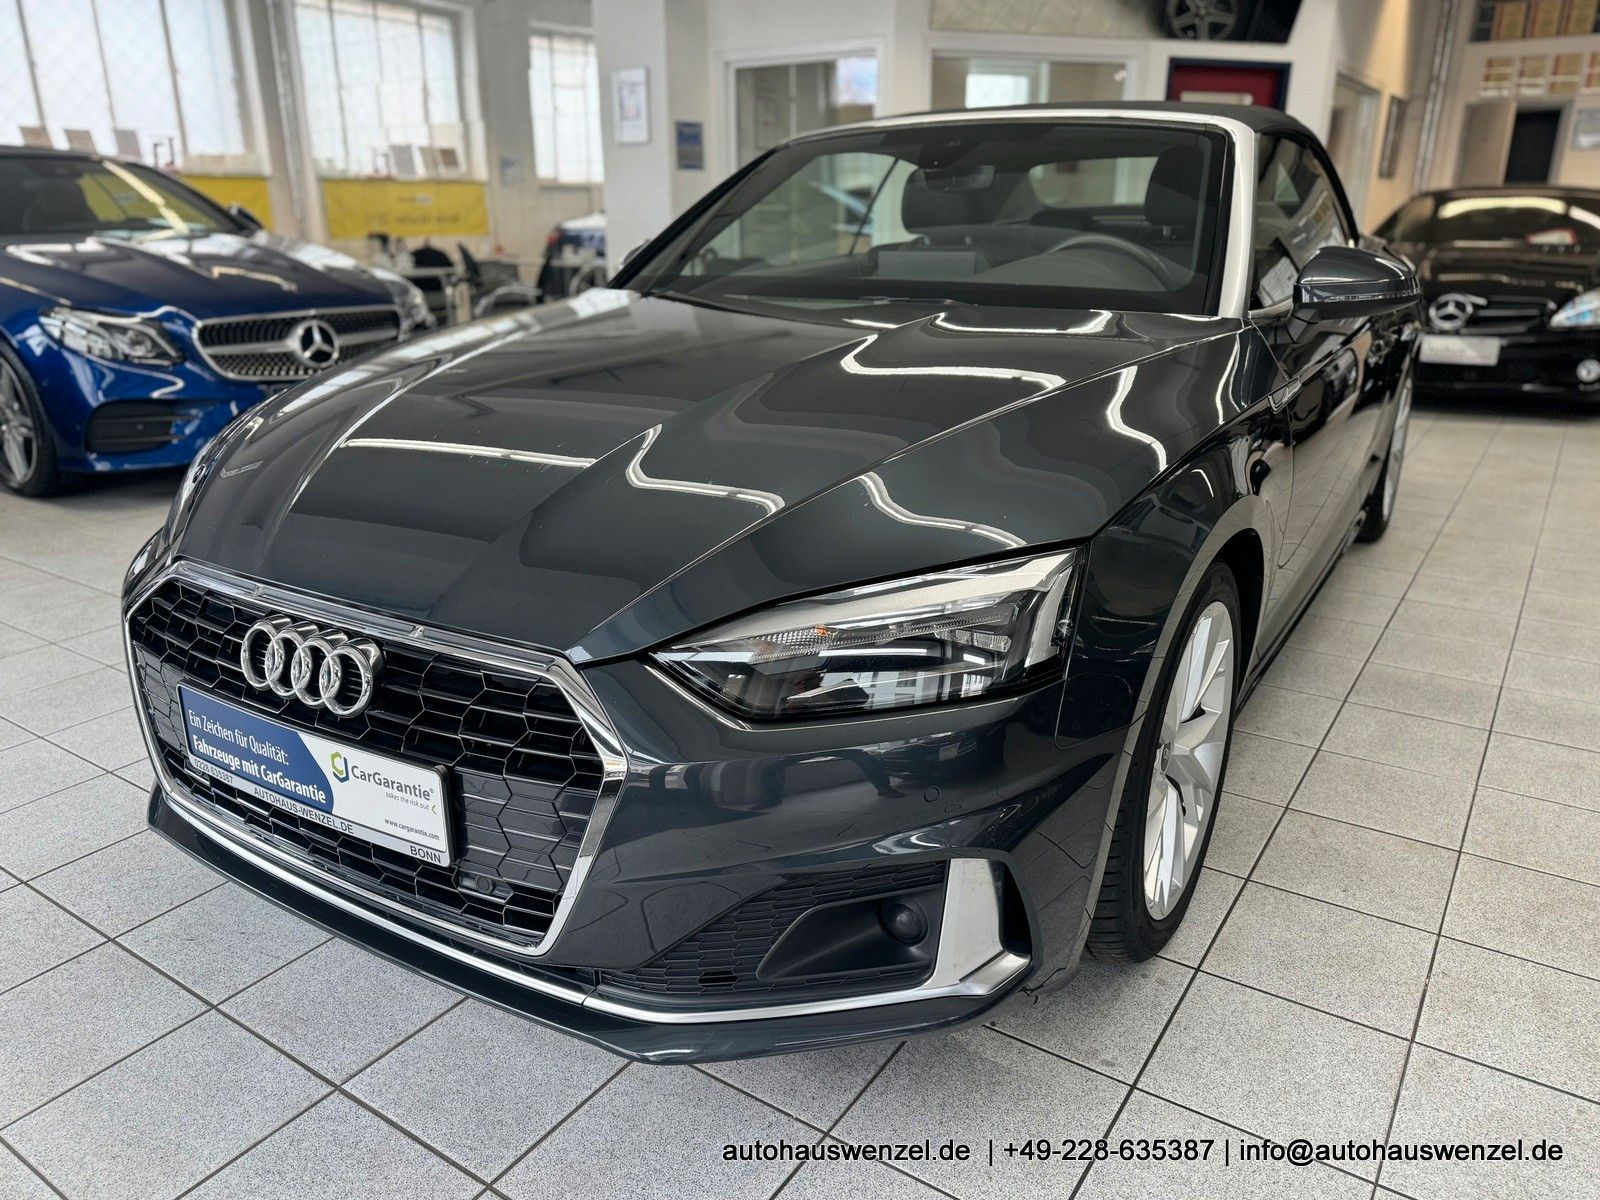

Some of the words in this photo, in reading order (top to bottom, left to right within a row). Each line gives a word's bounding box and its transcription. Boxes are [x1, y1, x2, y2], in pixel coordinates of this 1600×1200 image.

[189, 709, 202, 728] Ein
[201, 715, 235, 742] Zeichen
[235, 729, 249, 748] für
[249, 737, 289, 766] Qualität:
[193, 735, 241, 771] Fahrzeuge
[242, 760, 260, 779] mit
[260, 764, 327, 804] CarGarantie
[194, 757, 209, 773] 0228
[254, 786, 354, 835] AUTOHAUS-WENZEL.DE
[384, 818, 440, 841] www.cargarantie.com
[410, 845, 442, 864] BONN
